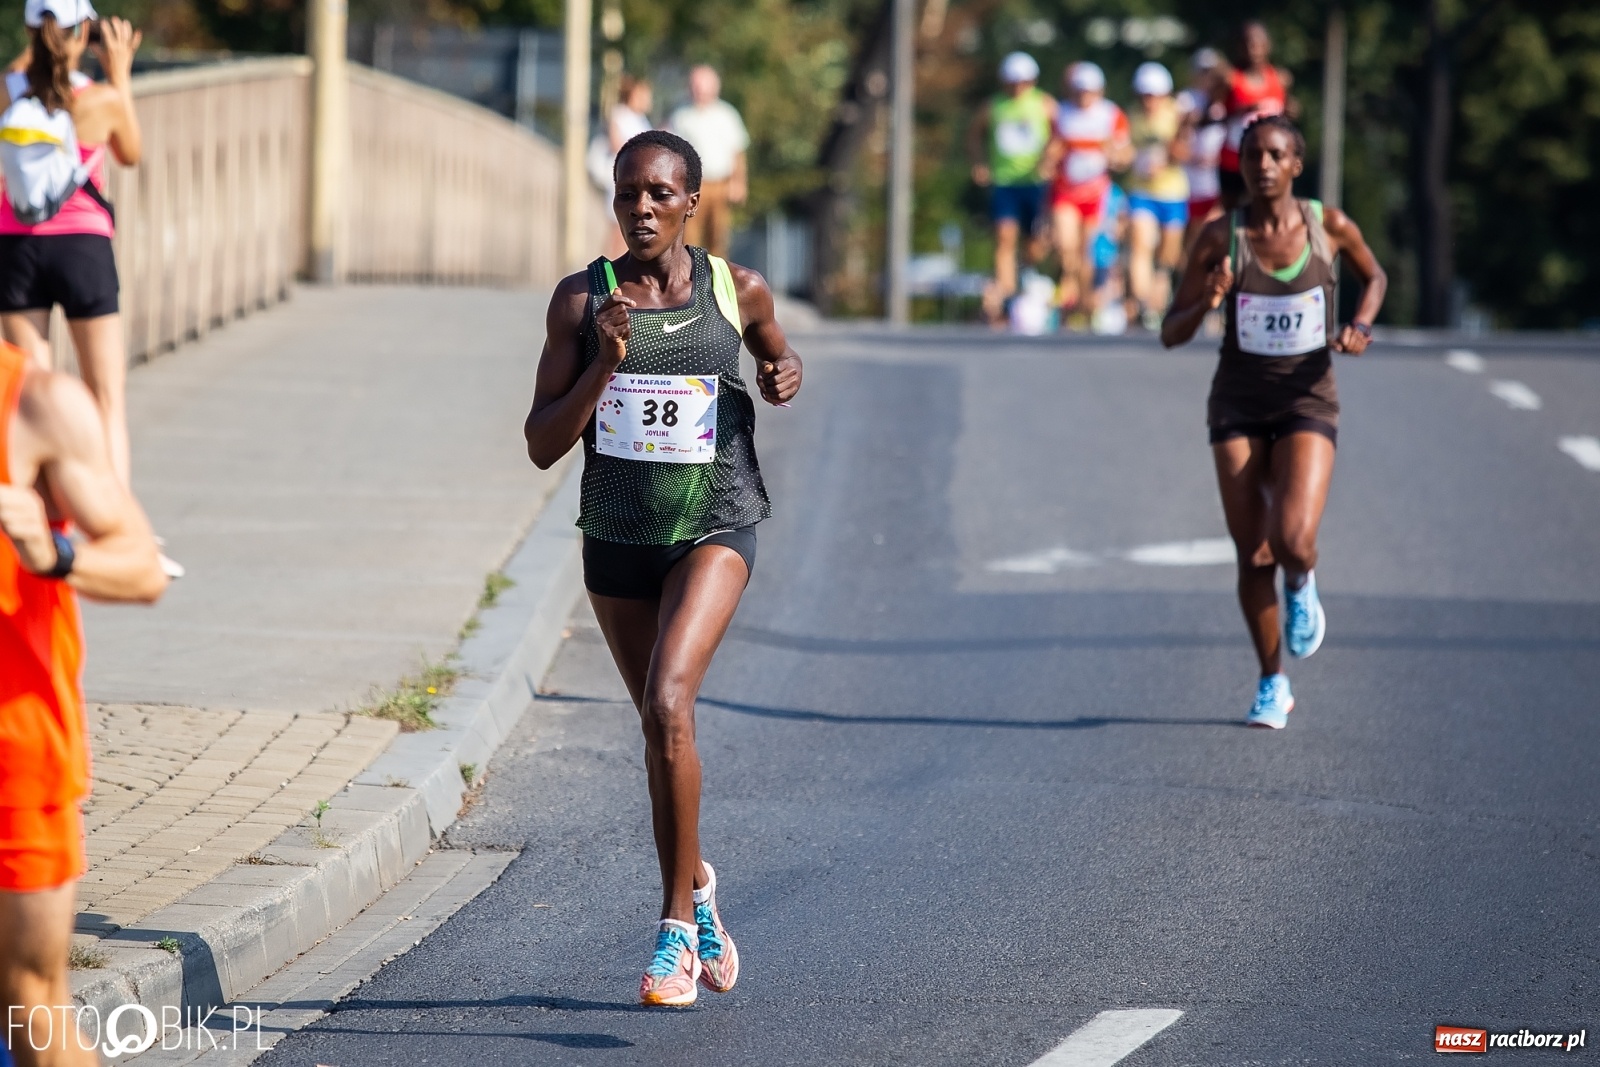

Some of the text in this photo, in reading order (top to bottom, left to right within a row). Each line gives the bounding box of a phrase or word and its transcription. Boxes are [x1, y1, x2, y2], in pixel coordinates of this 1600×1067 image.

[1265, 312, 1303, 332] 207
[642, 399, 678, 427] 38
[645, 430, 670, 438] JOYLINE
